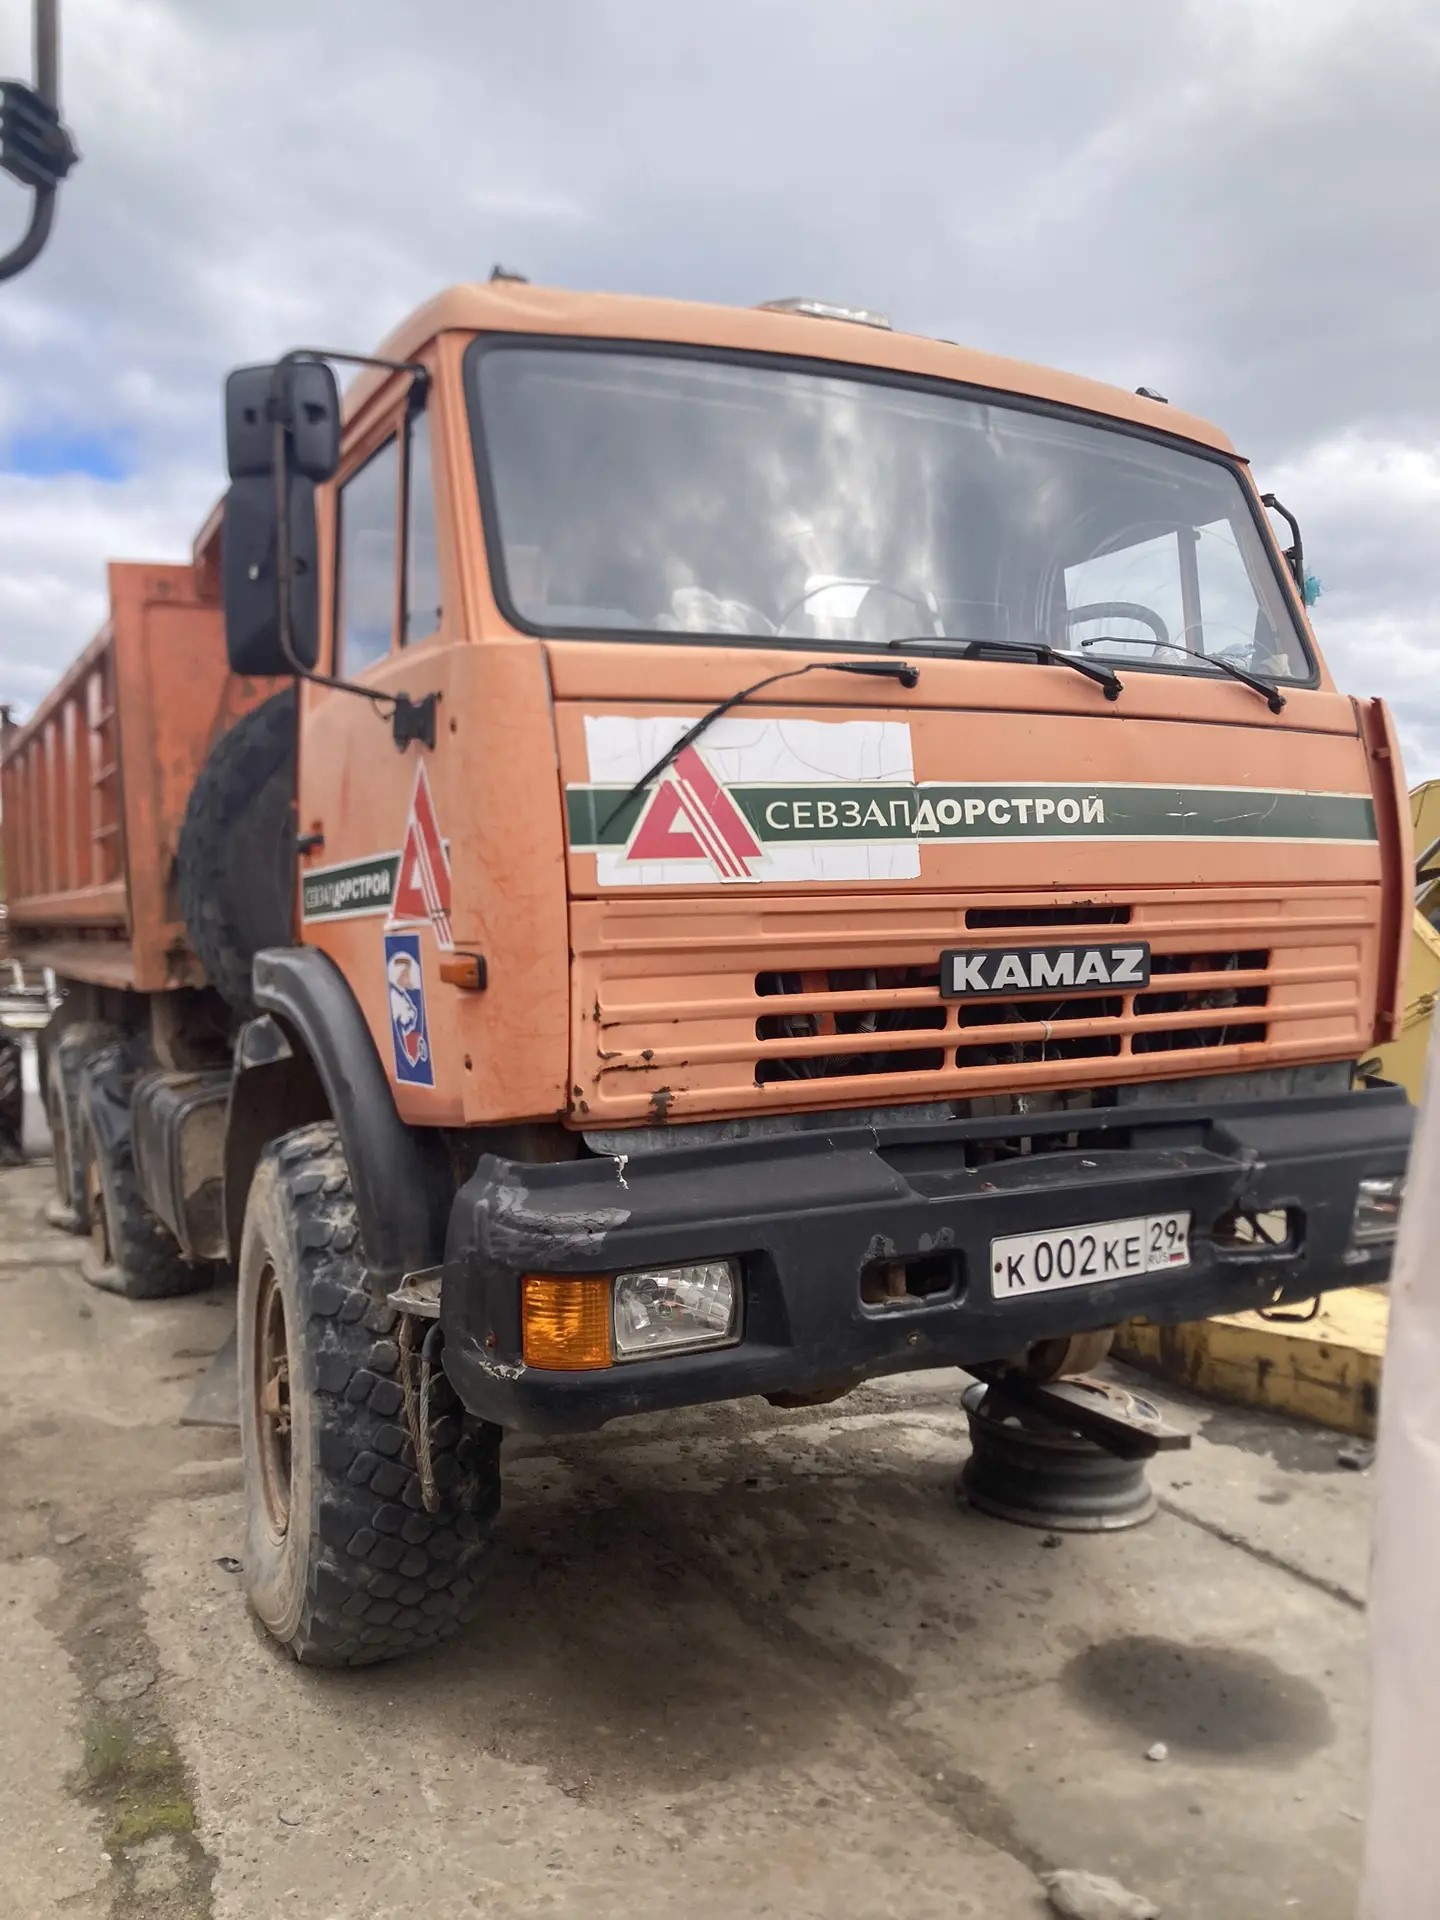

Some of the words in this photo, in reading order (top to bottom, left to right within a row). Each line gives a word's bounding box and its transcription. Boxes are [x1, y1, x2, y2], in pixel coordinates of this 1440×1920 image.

[765, 794, 1105, 834] СЕВЗАПДОРСТРОЙ
[952, 949, 1144, 991] KAMAZ
[1151, 1219, 1178, 1251] 29
[1148, 1251, 1169, 1265] RUS
